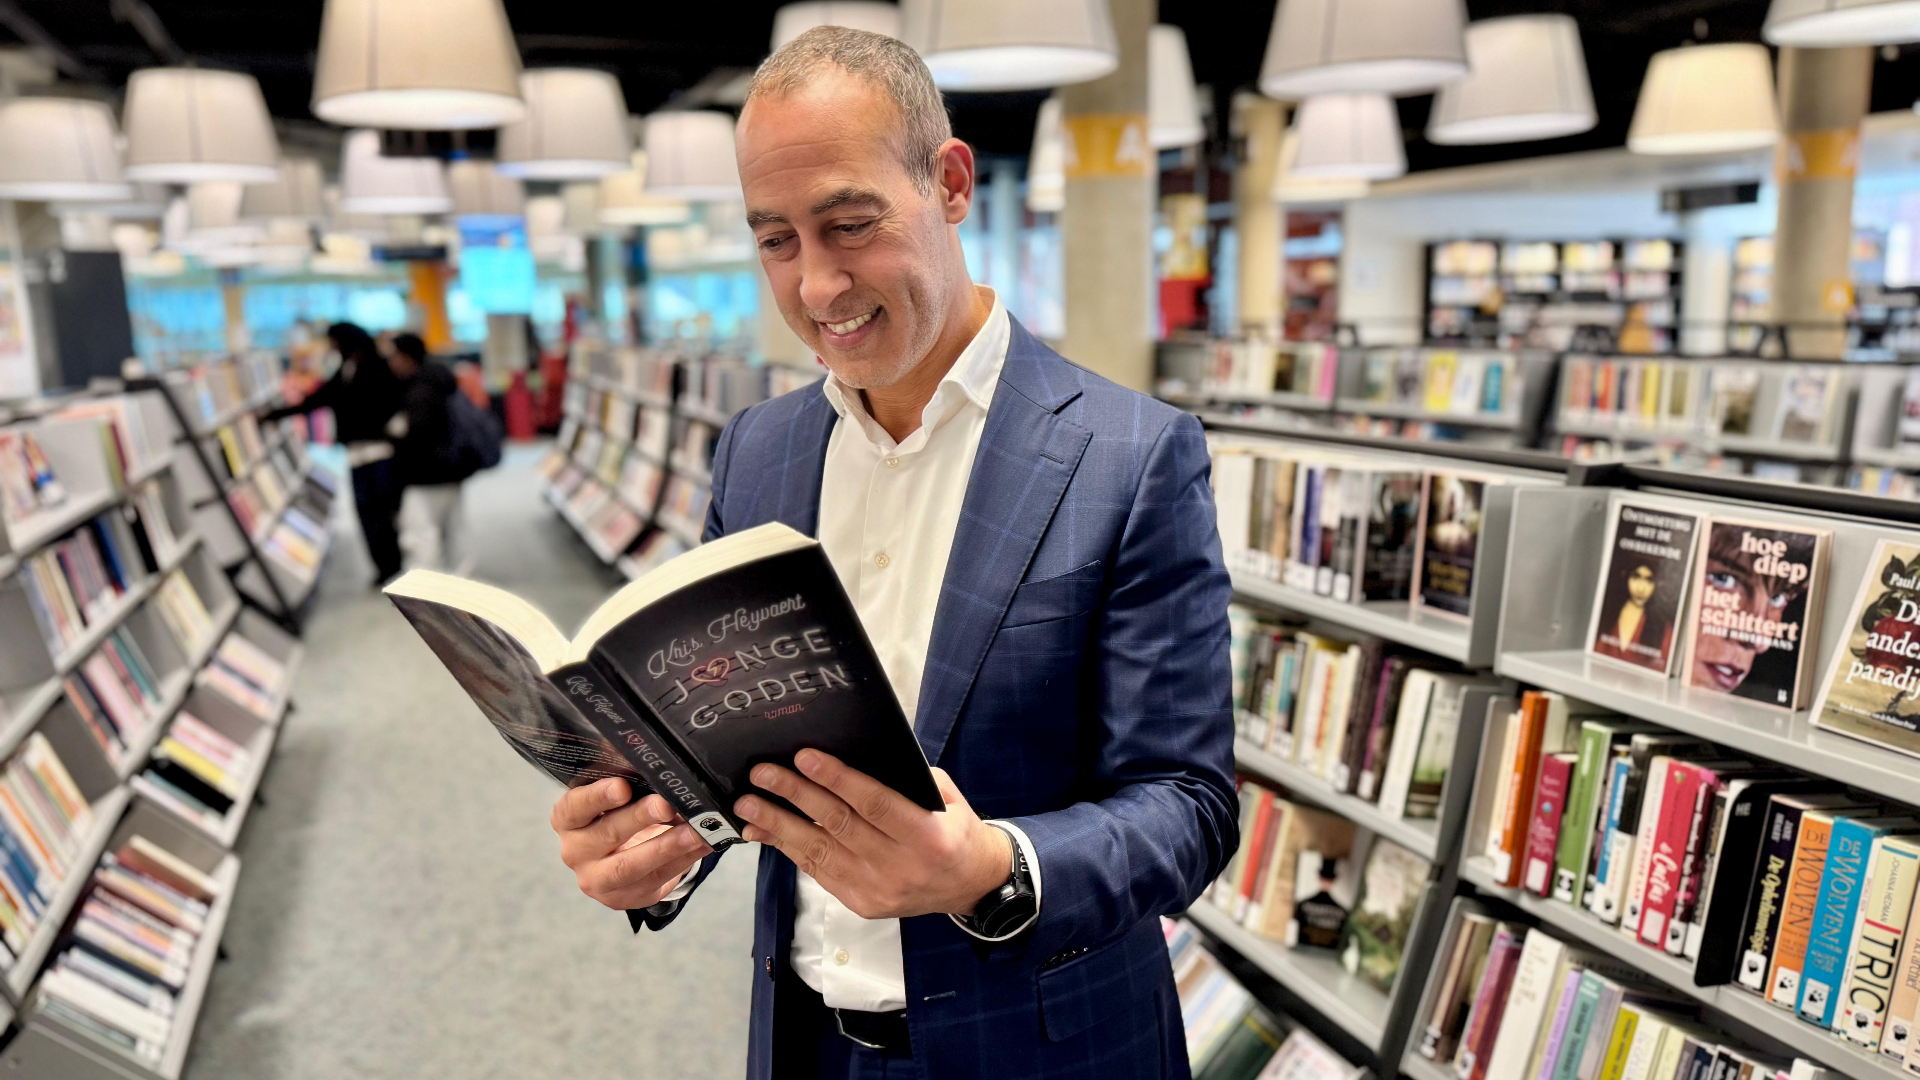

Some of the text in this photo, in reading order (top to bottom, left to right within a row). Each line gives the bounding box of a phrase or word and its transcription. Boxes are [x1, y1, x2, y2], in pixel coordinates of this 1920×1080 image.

[1741, 531, 1788, 558] hoe
[1753, 554, 1808, 584] diep
[1889, 572, 1917, 590] Paul
[1703, 585, 1742, 611] het
[647, 593, 806, 679] Kris Heyvaert
[1700, 607, 1799, 641] schittert
[691, 664, 849, 728] GODEN
[764, 703, 804, 719] roman
[566, 676, 592, 695] Kris
[659, 770, 703, 809] GODEN
[1735, 802, 1751, 817] HE
[1805, 829, 1829, 845] DE
[1839, 836, 1862, 856] DE
[1767, 854, 1785, 873] De
[1788, 846, 1828, 933] WOLVEN
[1820, 855, 1862, 944] WOLVEN
[1880, 856, 1901, 923] JOHANNA HEDMAN
